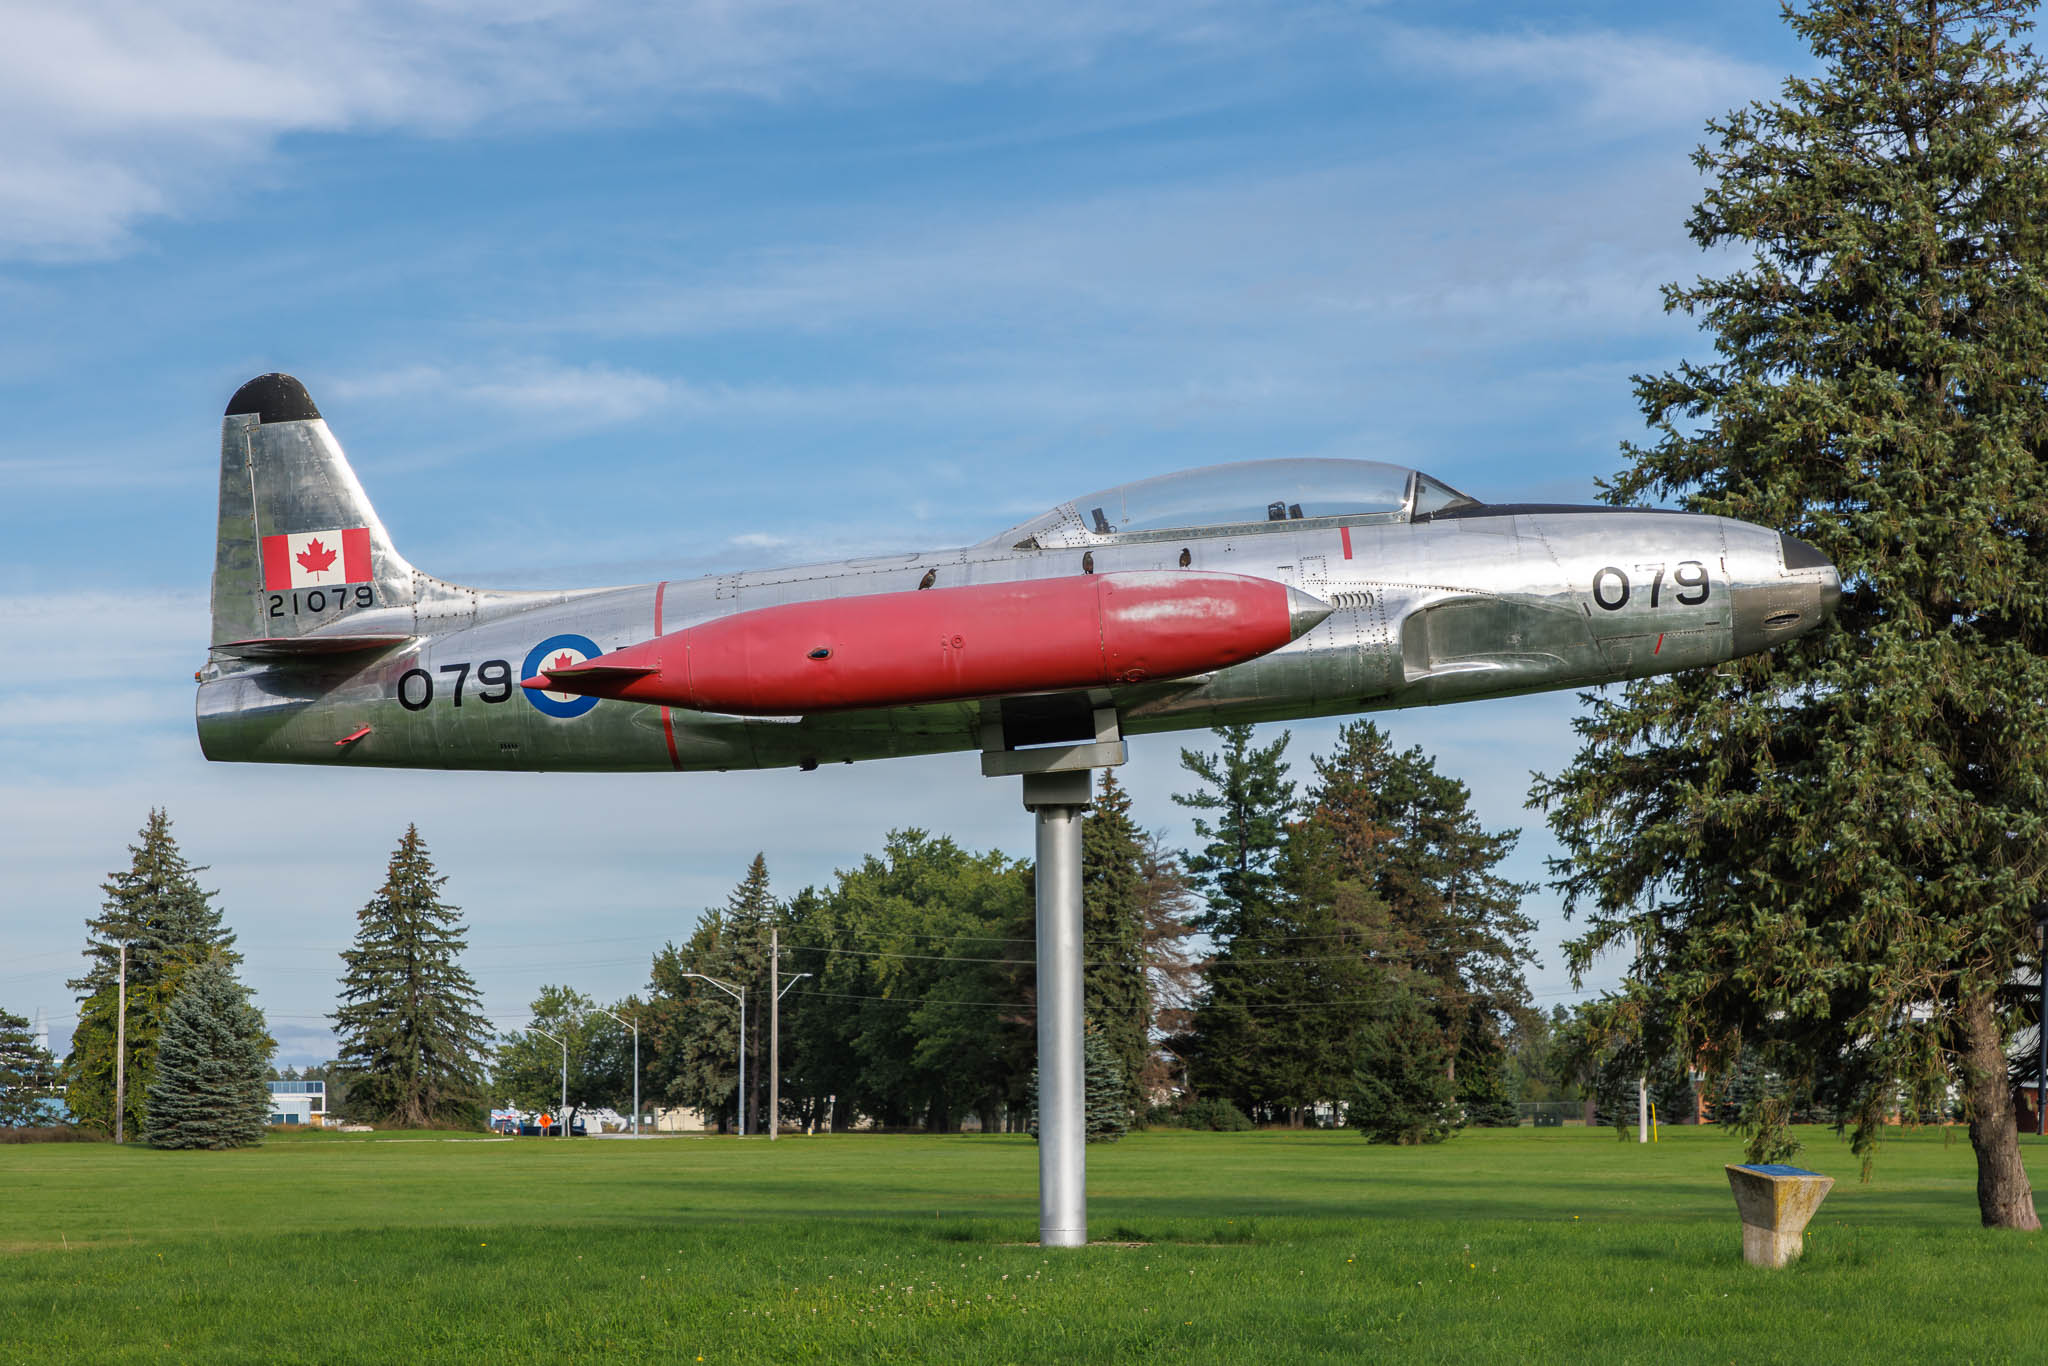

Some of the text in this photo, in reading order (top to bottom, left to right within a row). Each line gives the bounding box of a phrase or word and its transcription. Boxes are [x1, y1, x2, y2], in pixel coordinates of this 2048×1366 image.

[269, 586, 373, 618] 21079
[1593, 560, 1710, 611] 079
[398, 659, 512, 711] 079
